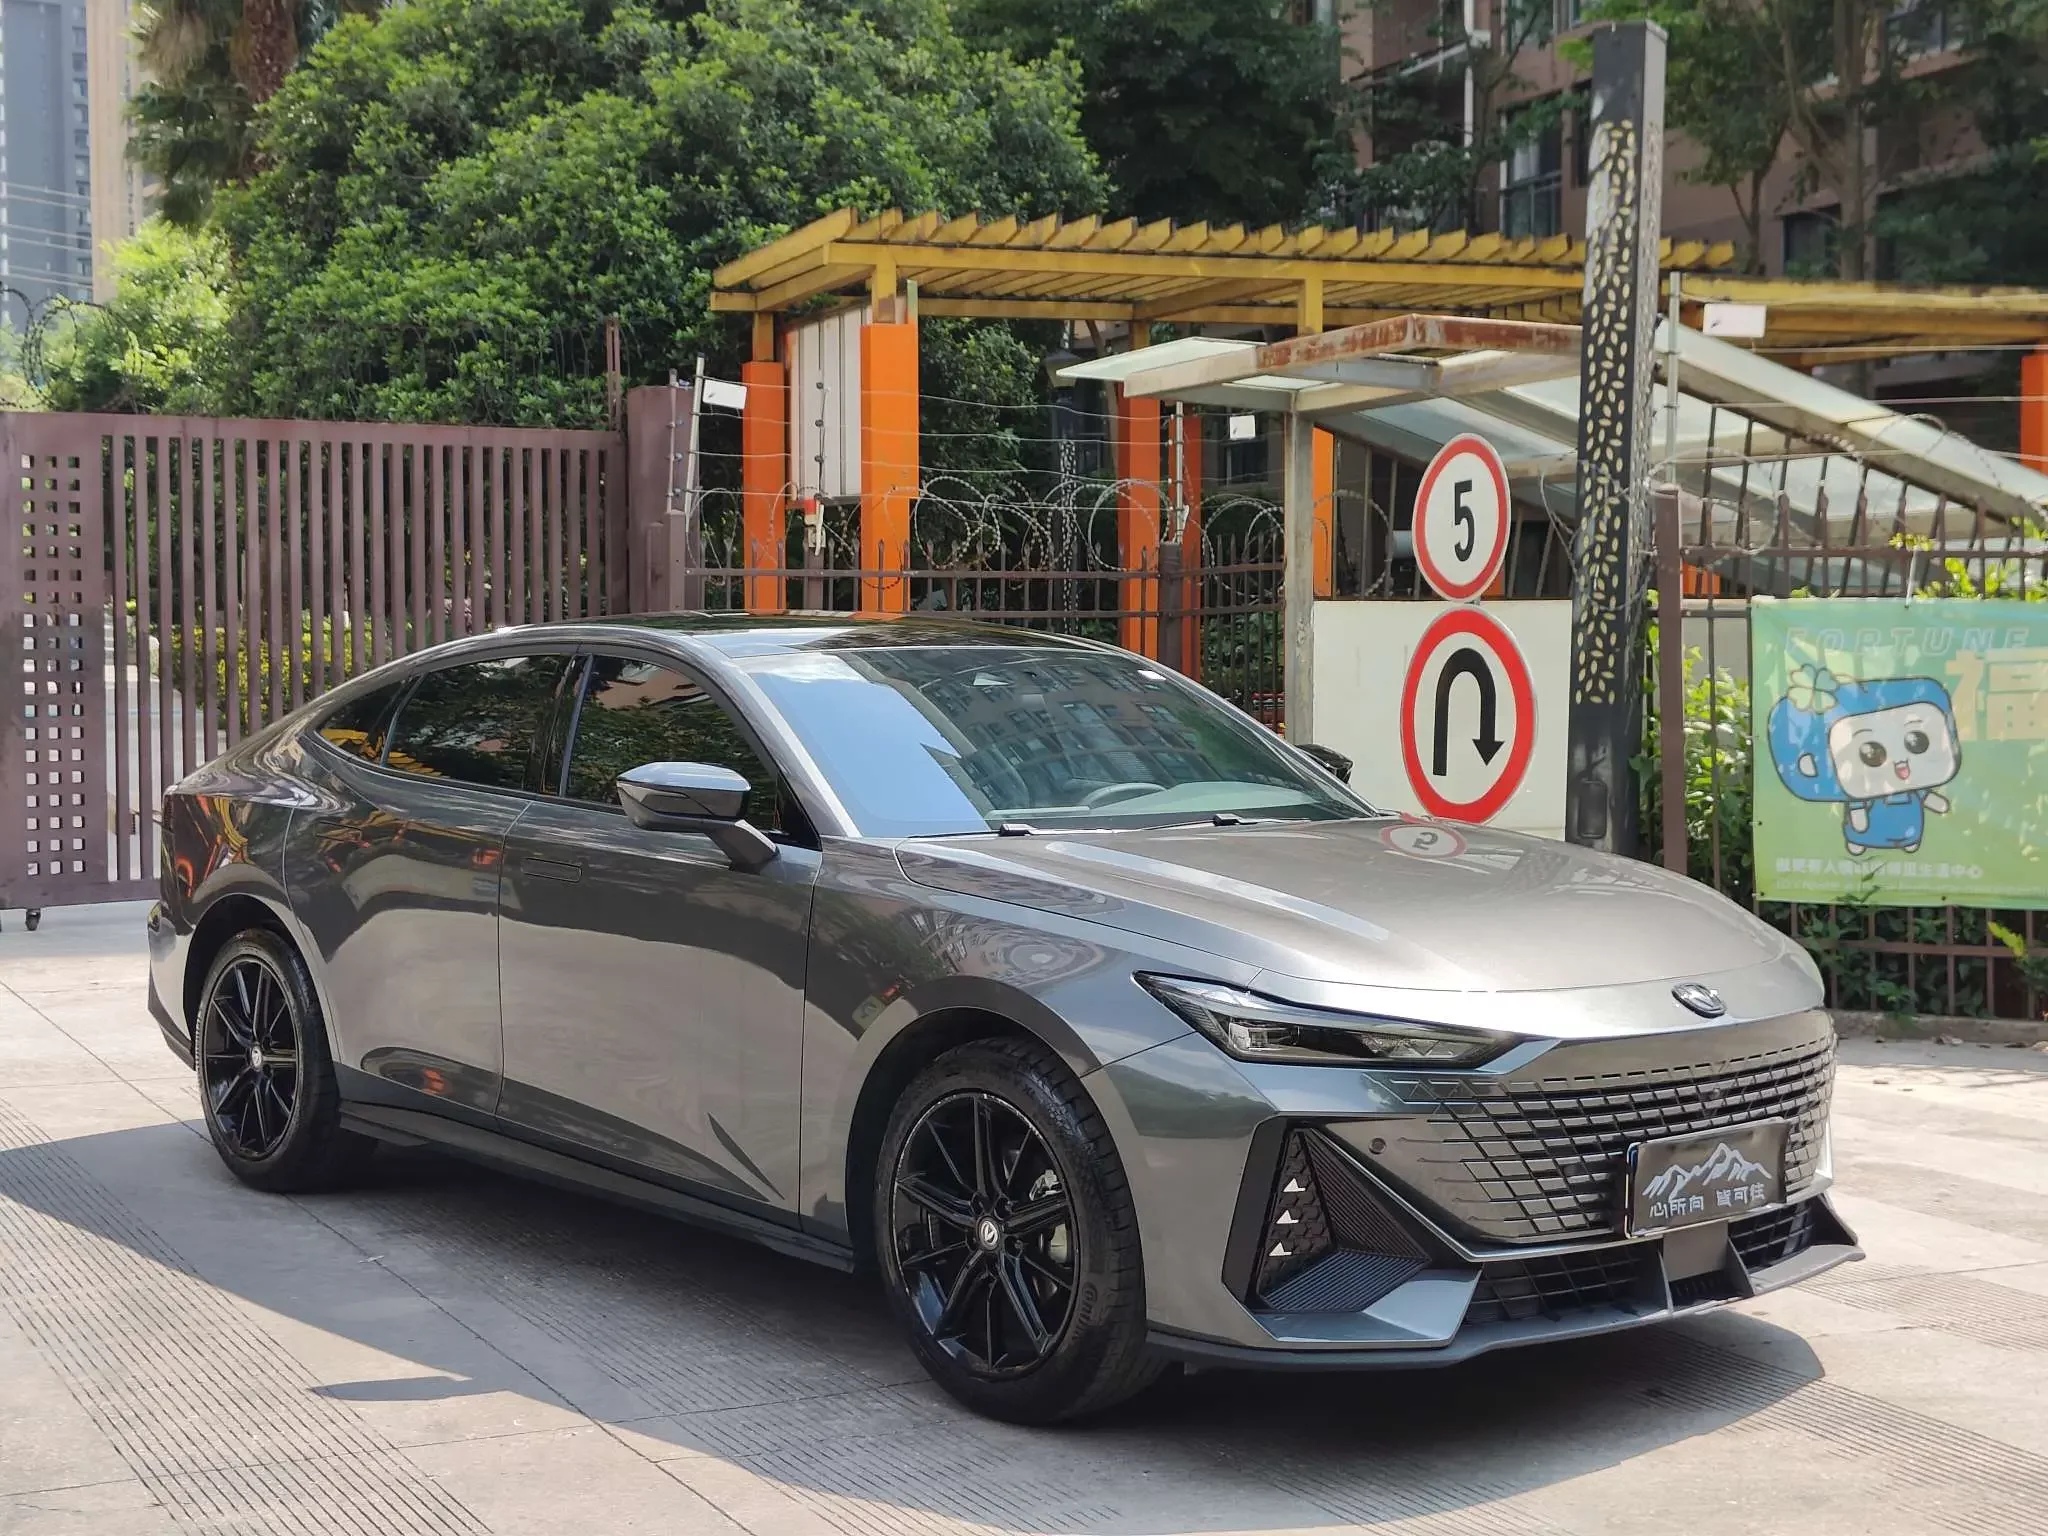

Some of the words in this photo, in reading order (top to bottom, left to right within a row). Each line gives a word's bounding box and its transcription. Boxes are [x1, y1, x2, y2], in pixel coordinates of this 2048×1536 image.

[1453, 480, 1476, 562] 5
[1786, 627, 2028, 656] FORTUNE
[1649, 1195, 1704, 1219] 心所向
